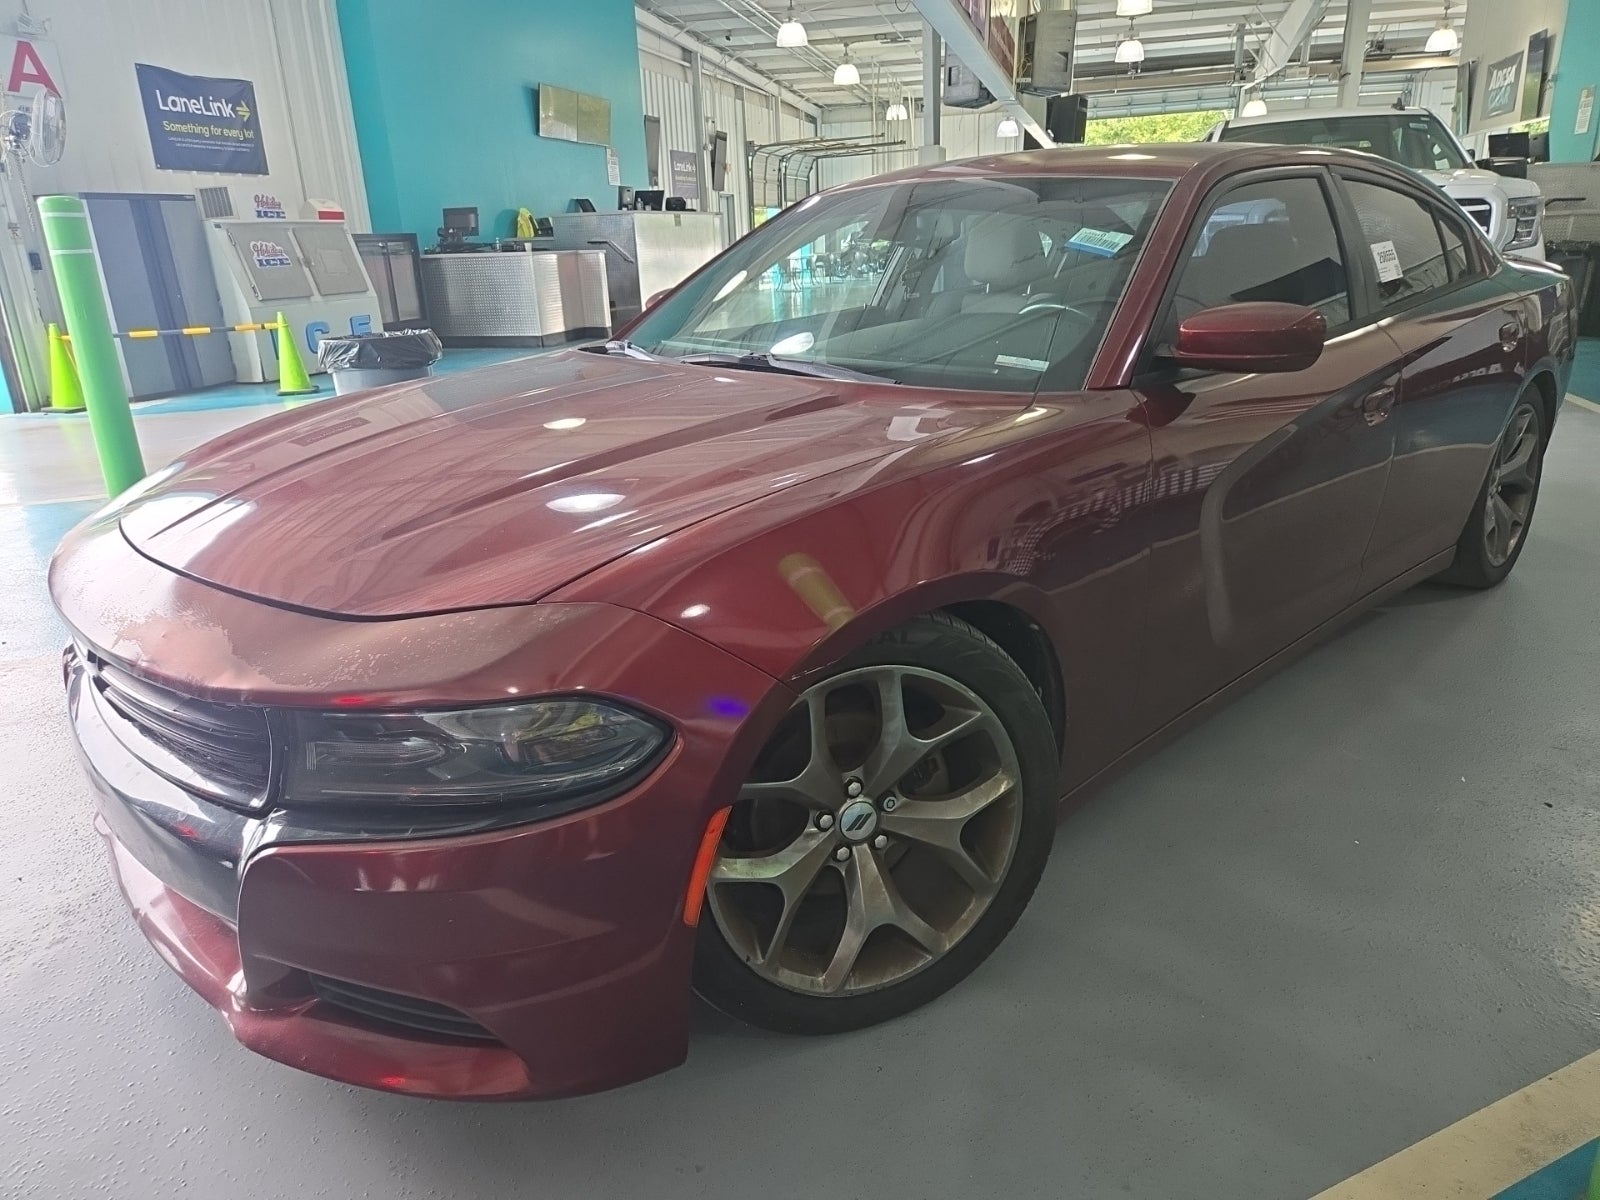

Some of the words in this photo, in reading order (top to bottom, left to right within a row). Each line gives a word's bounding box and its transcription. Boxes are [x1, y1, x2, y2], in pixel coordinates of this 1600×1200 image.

[7, 40, 62, 98] A
[156, 89, 236, 118] LaneLink
[163, 120, 210, 137] Something
[211, 125, 222, 136] for
[222, 129, 244, 140] every
[244, 129, 255, 139] lot
[254, 194, 281, 209] Holiday
[256, 210, 286, 219] ICE
[252, 243, 284, 257] Holiday
[257, 257, 291, 266] ICE
